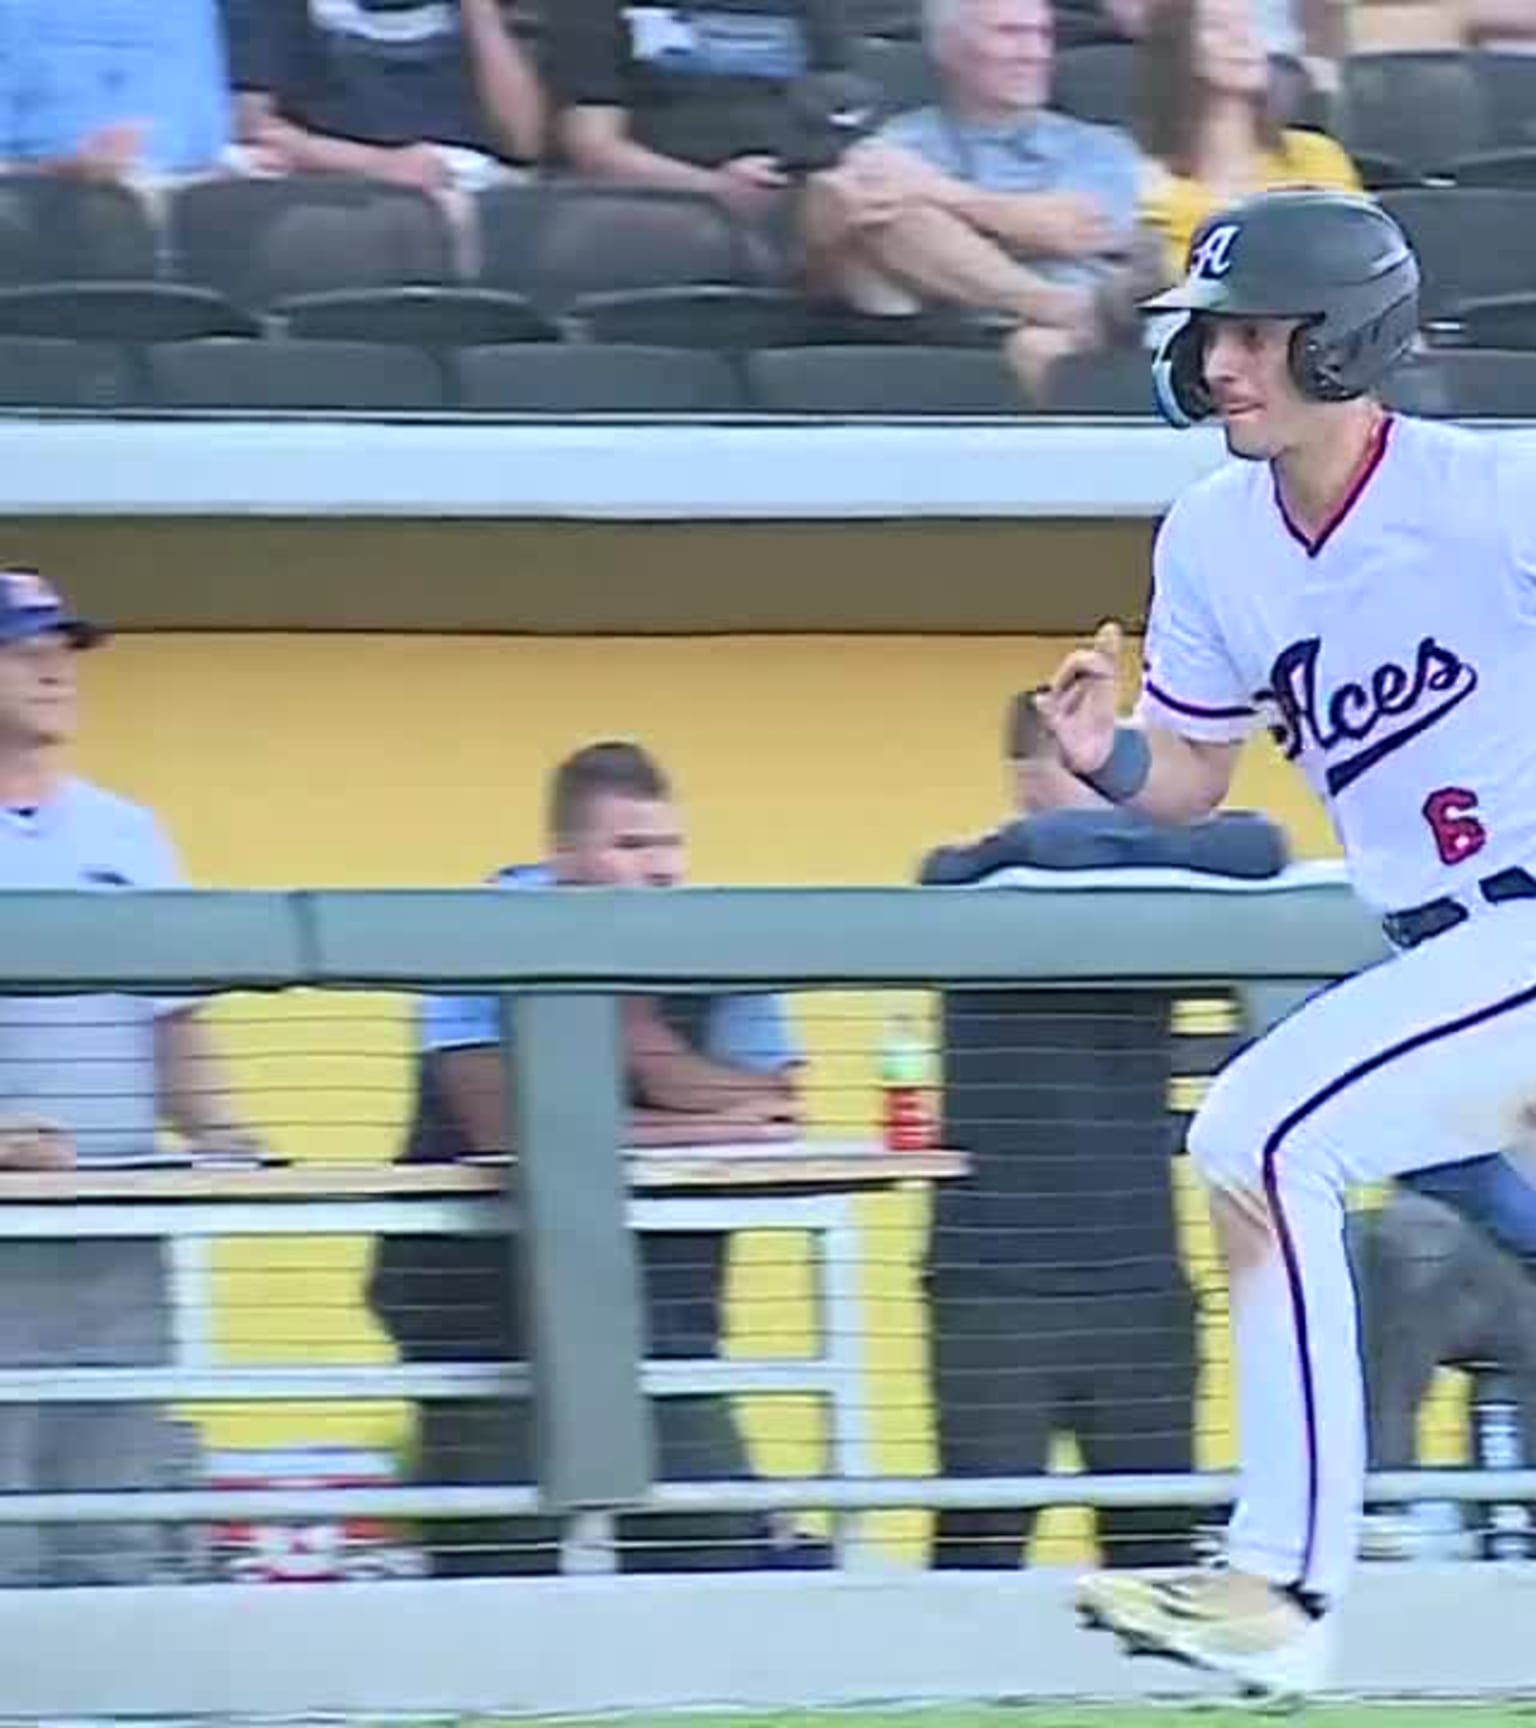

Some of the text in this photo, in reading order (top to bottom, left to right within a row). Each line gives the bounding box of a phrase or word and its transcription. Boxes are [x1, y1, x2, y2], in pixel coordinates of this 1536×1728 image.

[1190, 223, 1240, 280] A
[1252, 635, 1466, 762] Aces
[1421, 786, 1487, 867] 6
